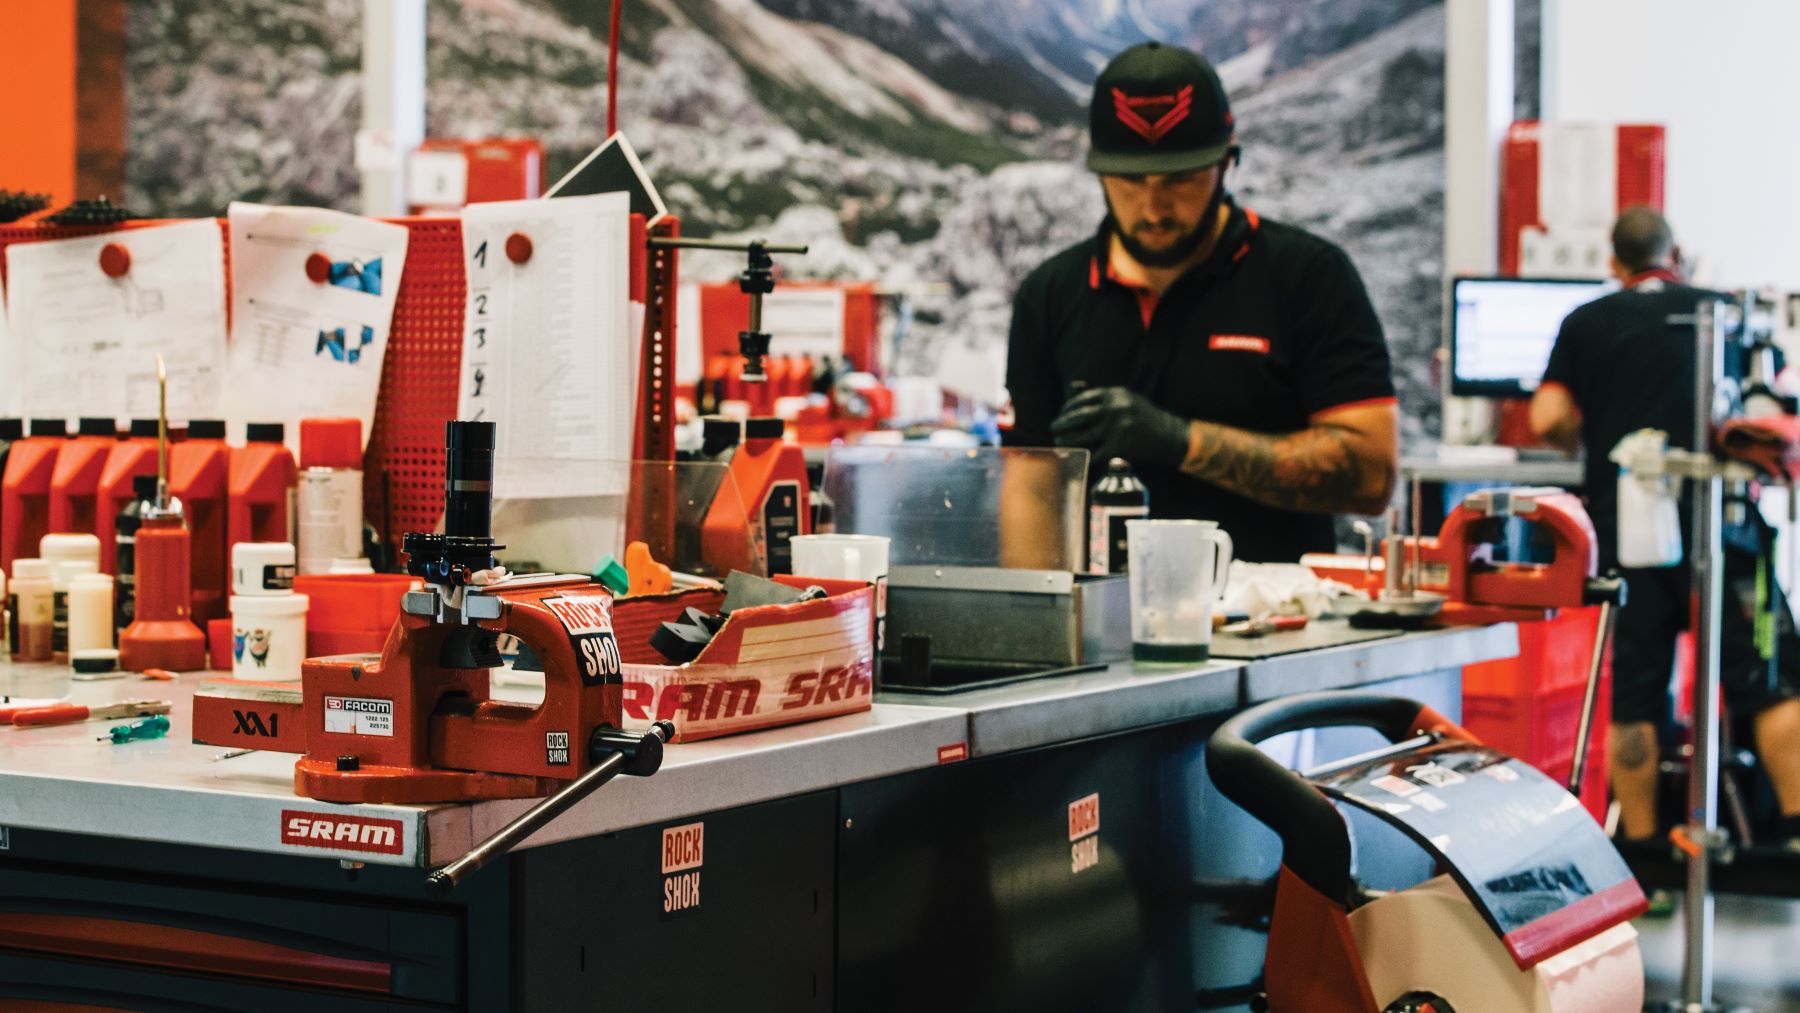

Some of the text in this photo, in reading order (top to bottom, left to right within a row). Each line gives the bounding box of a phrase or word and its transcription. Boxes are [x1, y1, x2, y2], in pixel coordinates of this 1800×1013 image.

[474, 240, 488, 268] 1
[475, 294, 488, 315] 2
[473, 328, 486, 349] 3
[580, 636, 619, 677] SHO
[622, 662, 873, 723] RAM SRA
[345, 701, 390, 713] FACOM
[548, 734, 567, 747] ROCK
[548, 749, 568, 763] SHOX
[287, 818, 396, 846] SRAM
[665, 827, 701, 868] ROCK
[664, 871, 700, 913] SHOX
